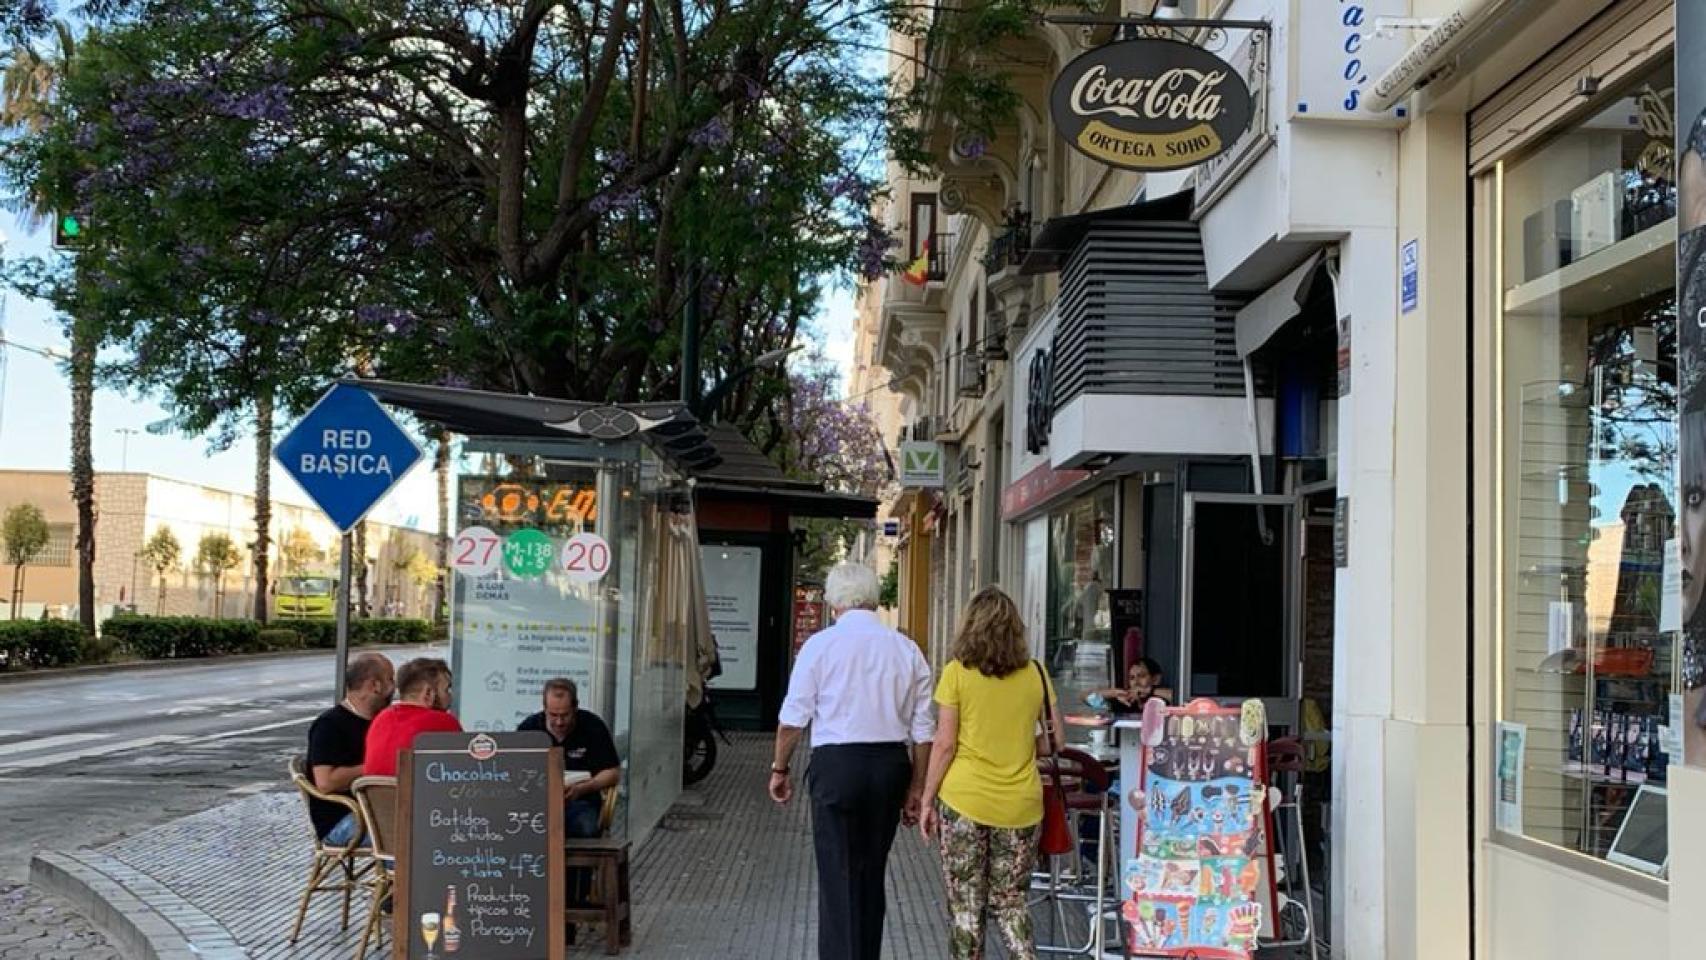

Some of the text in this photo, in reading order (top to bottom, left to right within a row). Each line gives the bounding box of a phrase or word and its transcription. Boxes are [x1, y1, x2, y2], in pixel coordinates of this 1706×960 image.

[1340, 0, 1367, 111] aco's
[1070, 64, 1228, 121] Coca-Cola
[1089, 131, 1211, 158] ORTEGA SOHO
[322, 428, 372, 450] RED
[300, 452, 392, 475] BASICA
[455, 536, 499, 566] 27
[505, 541, 553, 558] M-138
[566, 542, 608, 573] 20
[425, 761, 511, 784] Chocolate
[429, 807, 490, 828] Batidos
[432, 847, 507, 866] Bocadillos
[466, 882, 531, 903] Productos
[513, 902, 531, 919] de
[470, 918, 535, 948] Paraguay
